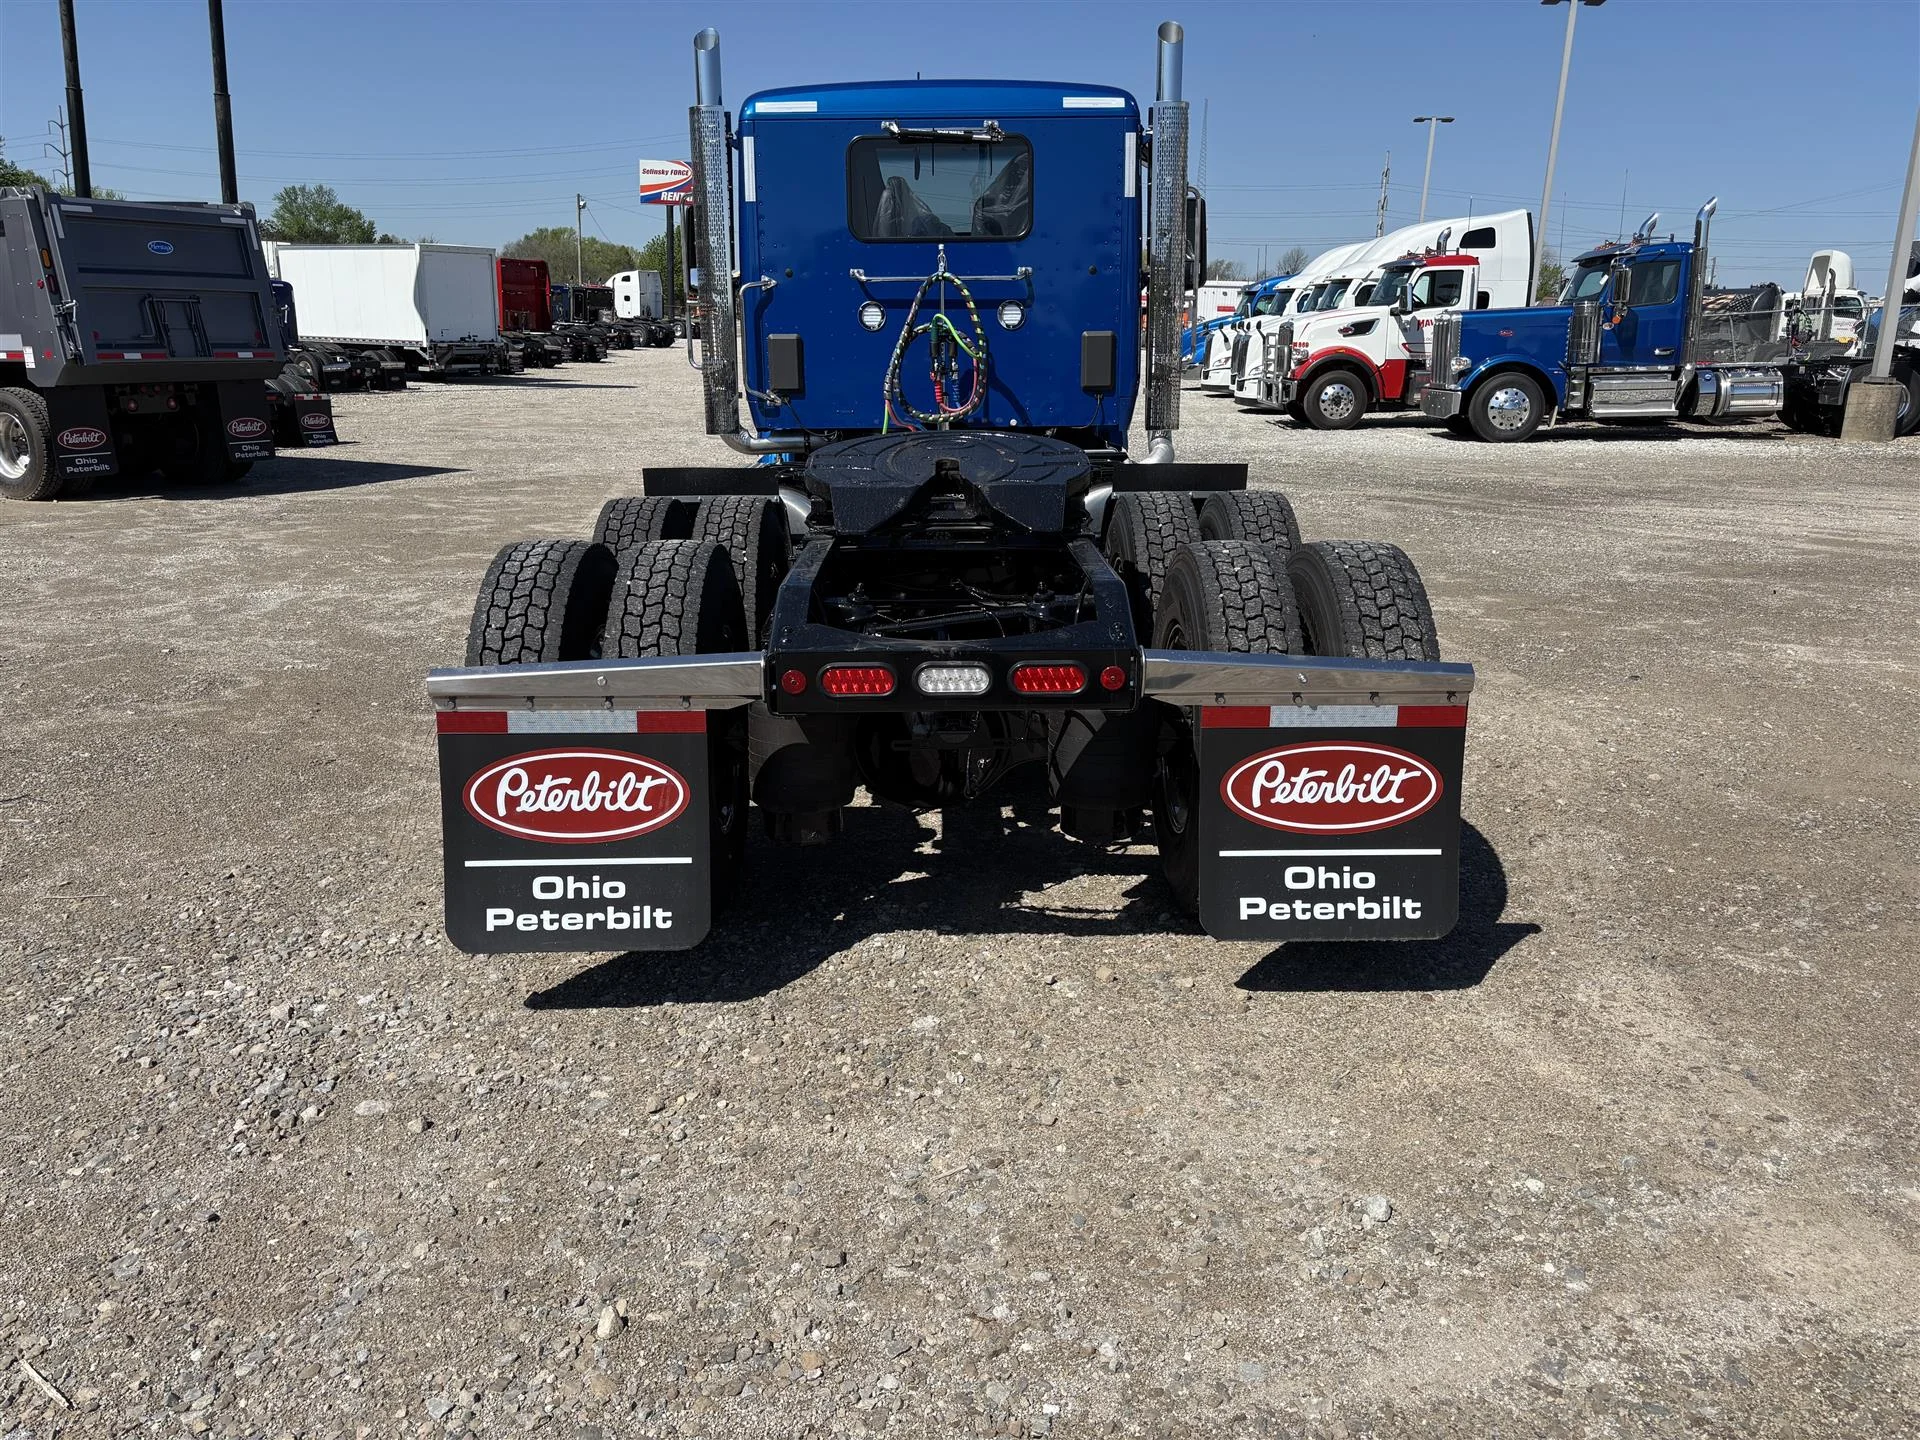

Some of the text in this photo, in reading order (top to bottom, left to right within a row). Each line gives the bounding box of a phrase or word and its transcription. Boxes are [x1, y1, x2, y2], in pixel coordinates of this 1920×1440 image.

[63, 432, 101, 444] Peterbilt
[75, 457, 98, 465] Ohio
[235, 450, 269, 459] Peterbilt
[66, 464, 110, 473] Peterbilt
[497, 768, 667, 816] Peterbilt
[1252, 761, 1421, 808] Peterbilt
[533, 876, 625, 899] Ohio
[1285, 866, 1375, 889] Ohio
[487, 906, 672, 931] Peterbilt
[1240, 896, 1421, 920] Peterbilt
